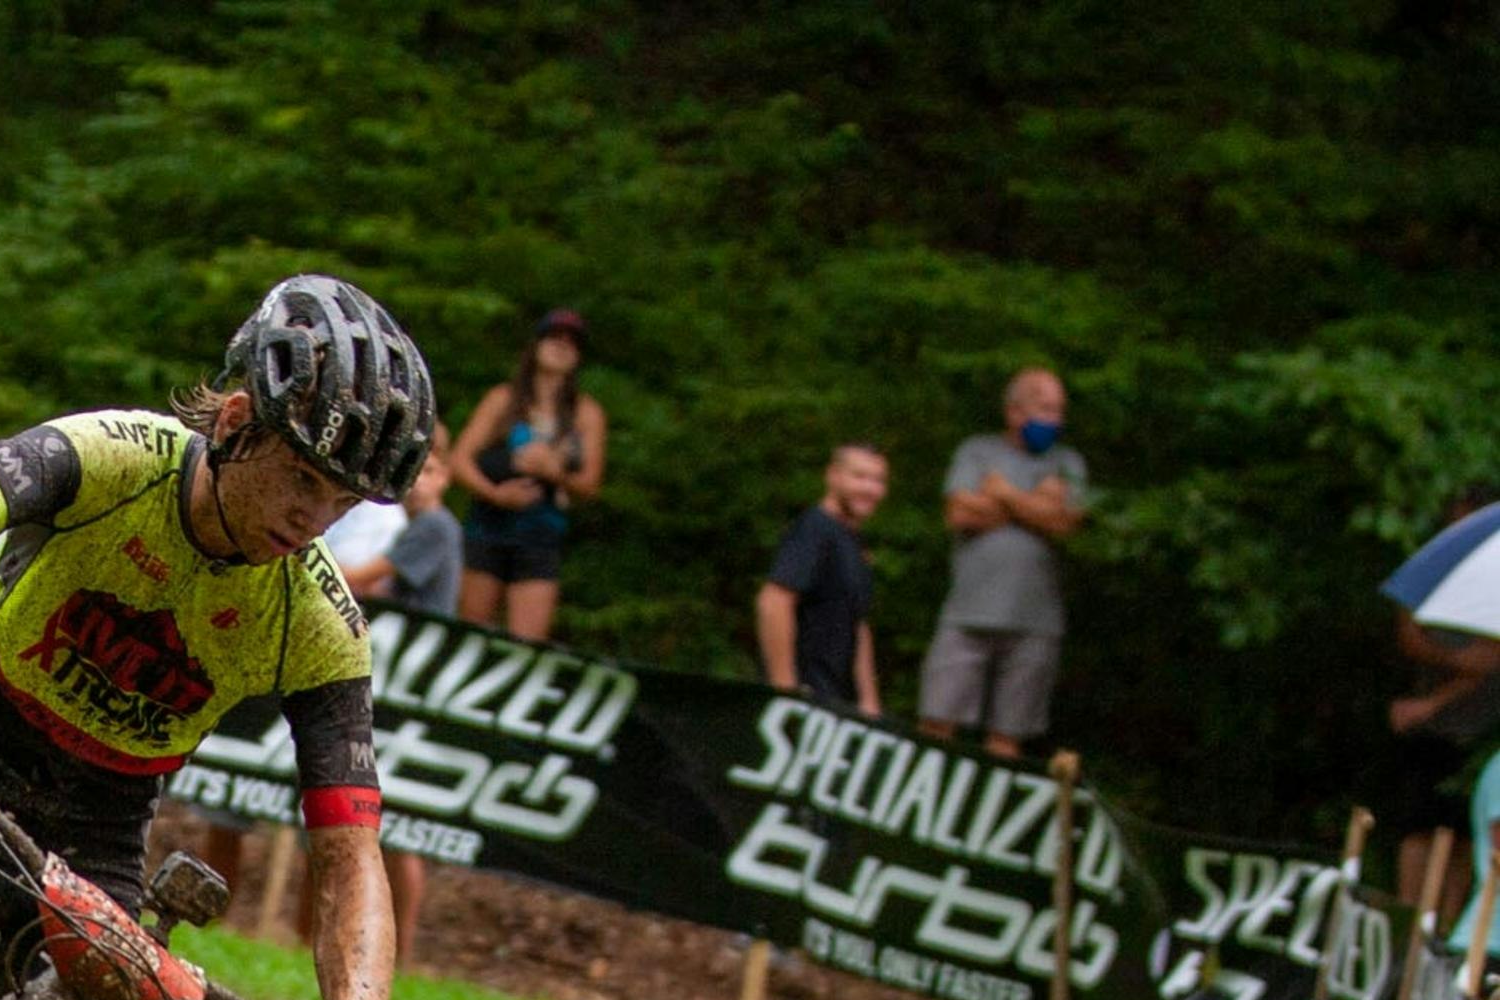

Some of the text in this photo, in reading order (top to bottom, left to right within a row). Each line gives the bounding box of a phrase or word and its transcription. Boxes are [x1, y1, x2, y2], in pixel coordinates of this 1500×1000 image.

[99, 419, 152, 451] LIVE
[156, 428, 177, 461] IT
[727, 803, 1118, 988] turbo
